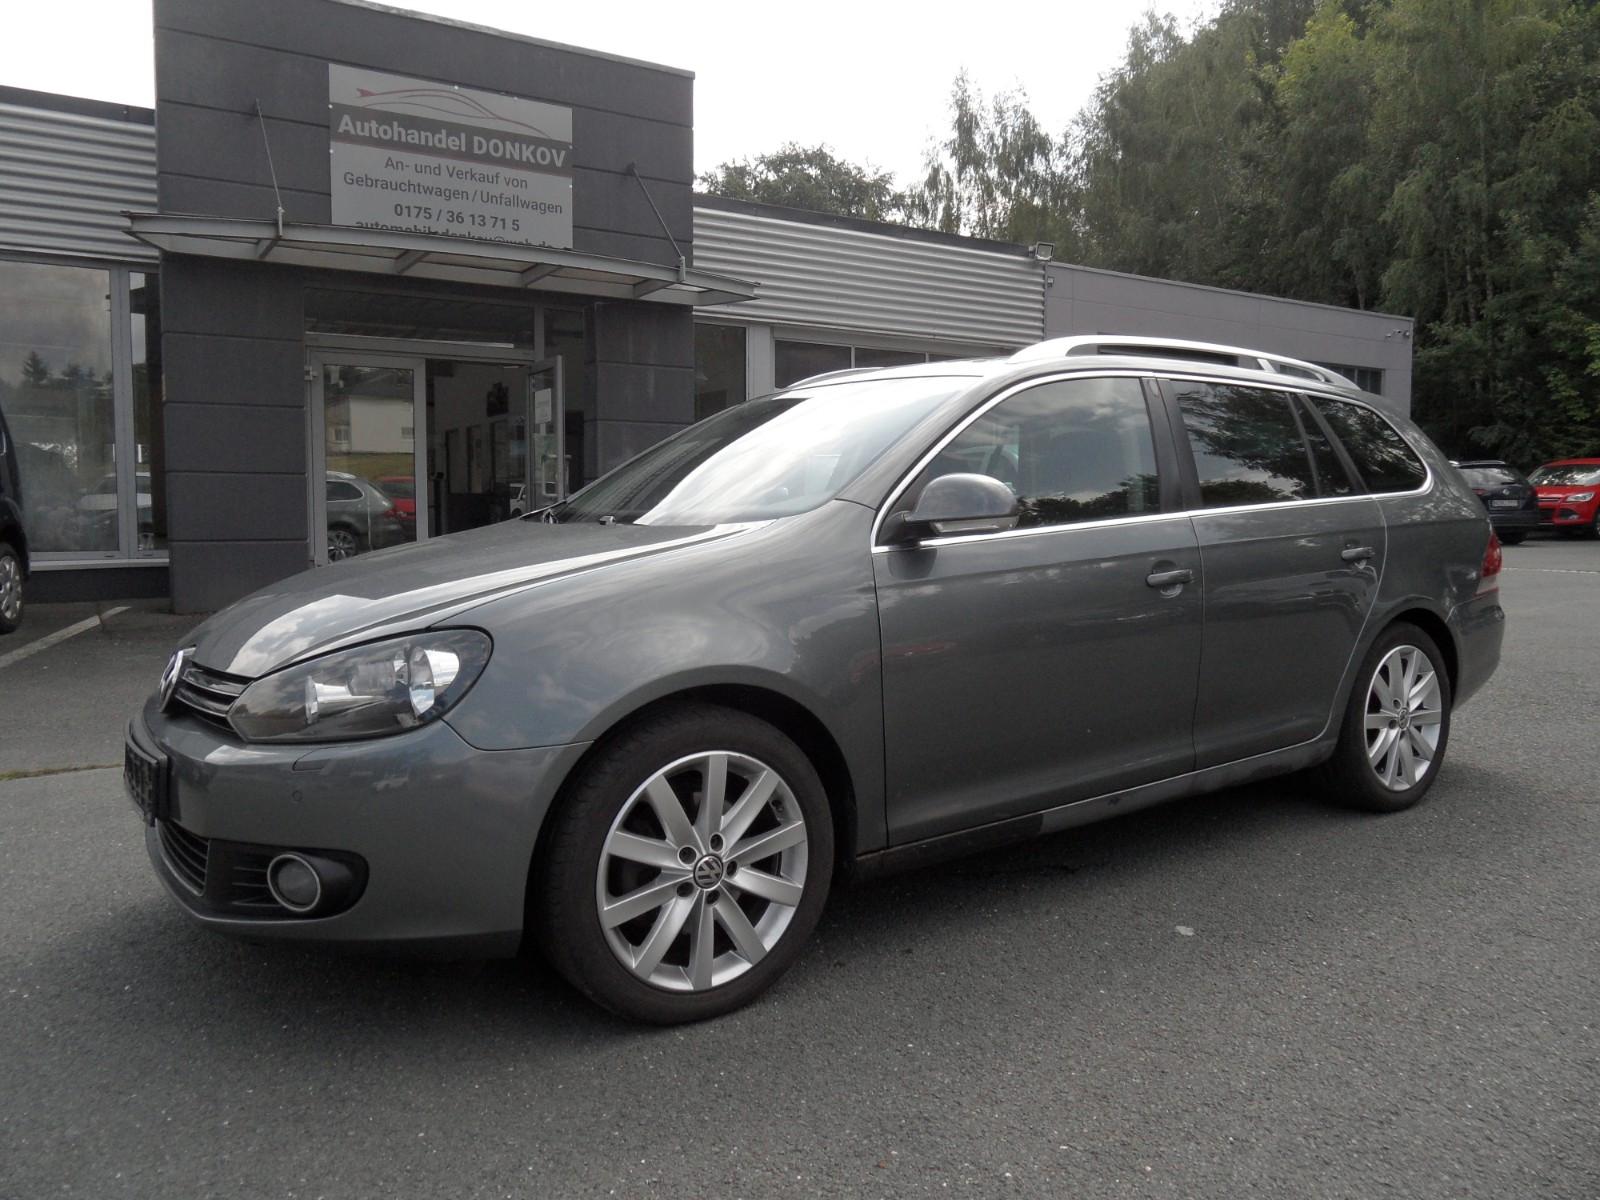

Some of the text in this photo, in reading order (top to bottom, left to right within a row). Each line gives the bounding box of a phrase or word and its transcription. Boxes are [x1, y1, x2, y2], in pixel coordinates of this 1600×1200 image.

[338, 114, 566, 168] Autohandel DONKOV
[384, 156, 528, 190] An- und Verkauf von
[343, 172, 469, 202] Gebrauchtwagen
[480, 190, 563, 215] Unfallwagen
[394, 203, 432, 220] 0175
[446, 210, 465, 225] 36
[511, 218, 520, 232] 5
